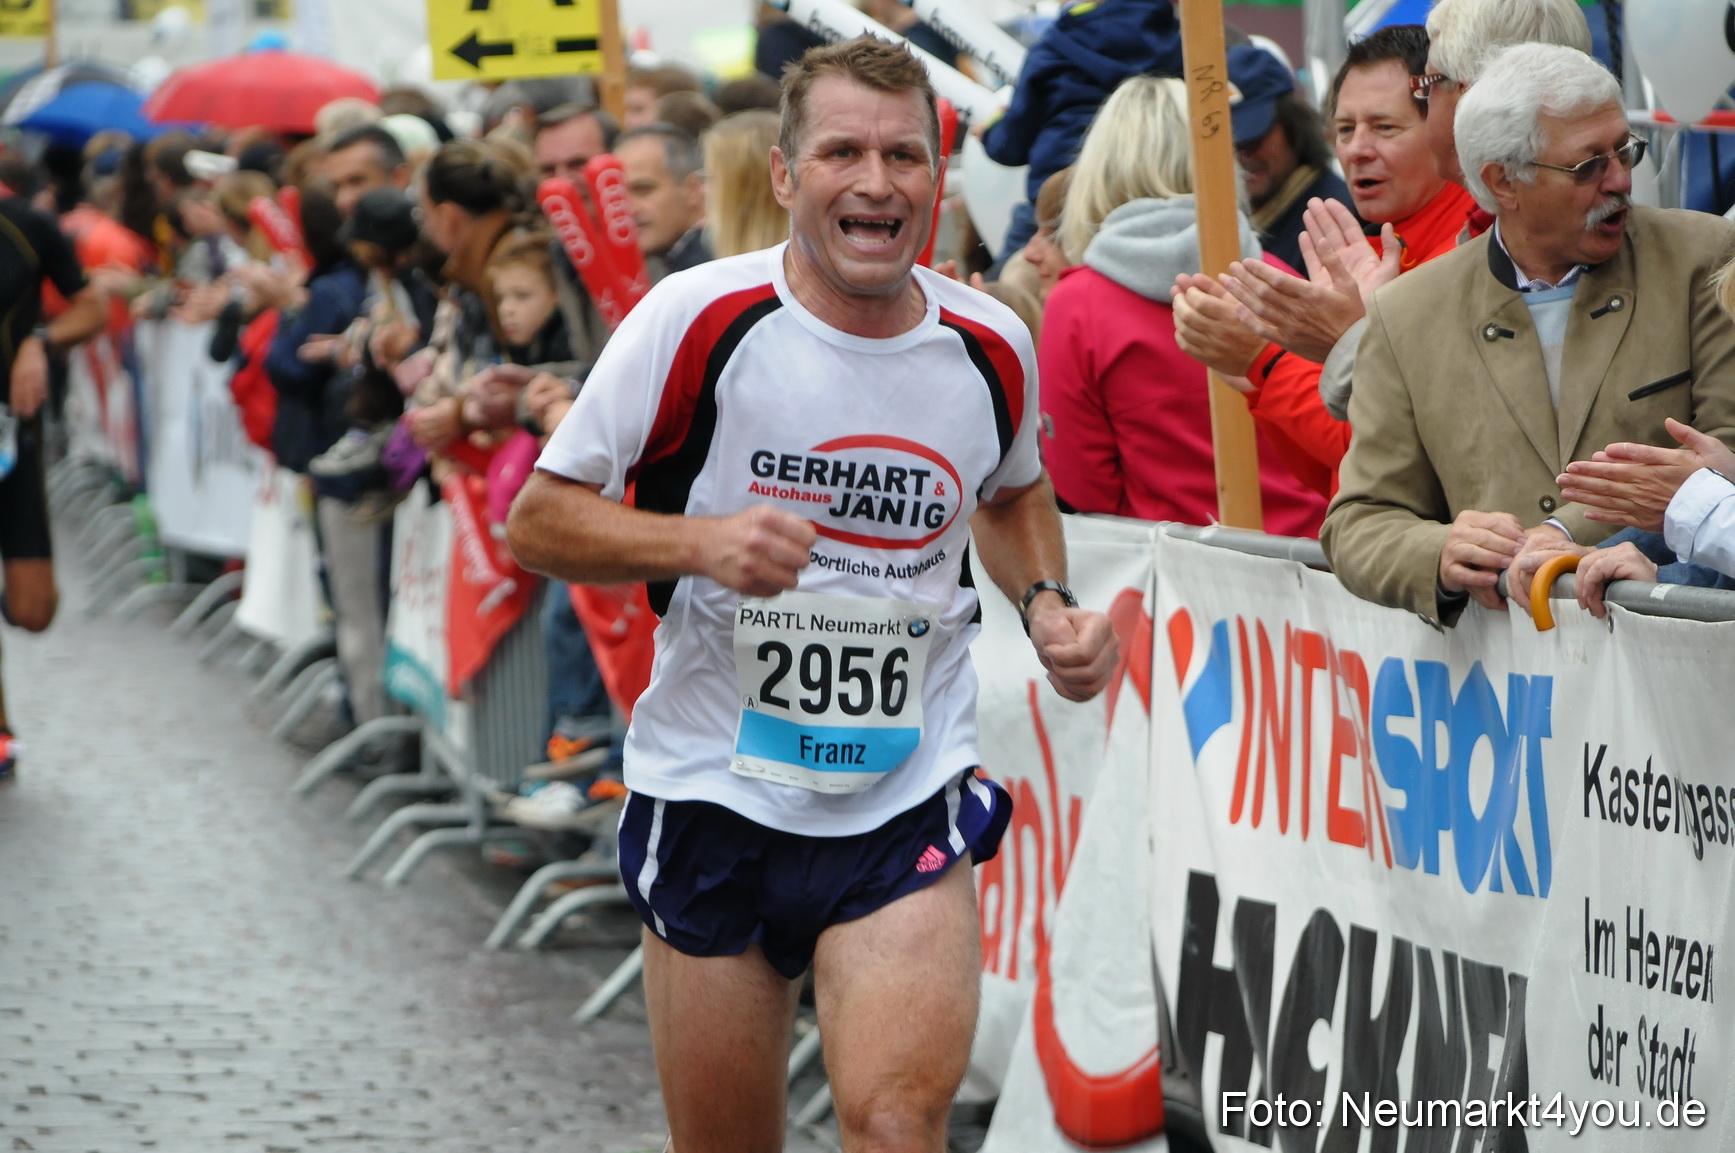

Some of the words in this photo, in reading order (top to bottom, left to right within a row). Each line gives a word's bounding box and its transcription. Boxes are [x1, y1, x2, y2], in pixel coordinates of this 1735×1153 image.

[1192, 64, 1223, 103] NR
[748, 480, 833, 504] Autohaus
[750, 449, 931, 497] GERHART
[933, 481, 945, 497] &
[828, 493, 946, 529] JÄNIG
[808, 549, 880, 578] portliche
[884, 548, 946, 579] Autohaus
[739, 608, 806, 631] PARTL
[809, 614, 901, 636] Neumarkt
[756, 640, 909, 717] 2956
[799, 734, 867, 765] Franz
[1228, 613, 1555, 899] INTERSPORT
[1584, 896, 1616, 978] Im
[1626, 905, 1714, 1004] Herzen
[1587, 1003, 1628, 1087] der
[1636, 1014, 1697, 1106] Stadt
